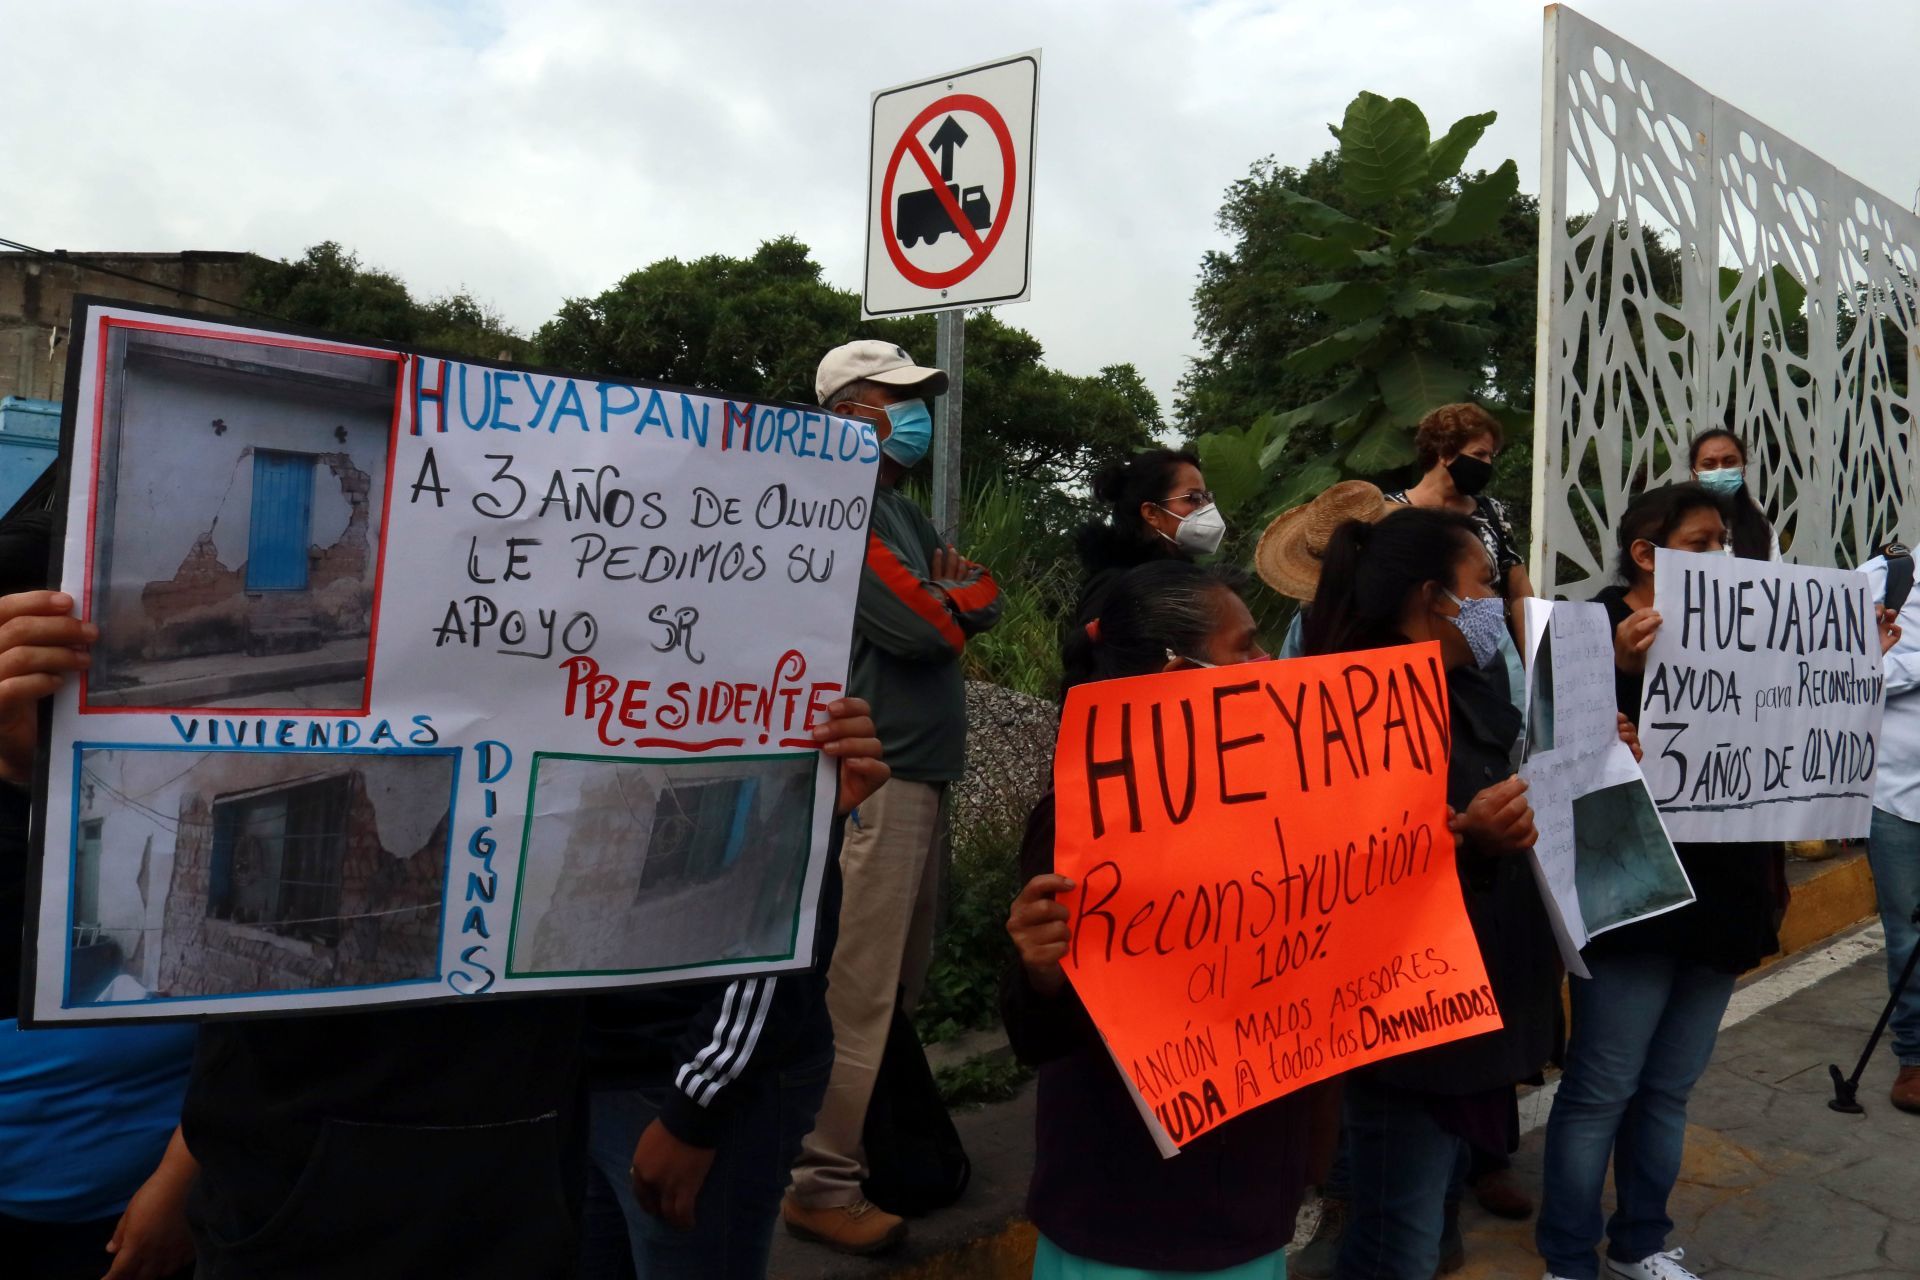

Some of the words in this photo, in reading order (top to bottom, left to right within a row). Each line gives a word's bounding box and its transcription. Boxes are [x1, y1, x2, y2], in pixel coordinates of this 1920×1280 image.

[409, 356, 709, 447] HUEYAPAN
[722, 399, 880, 463] MORELOS
[411, 447, 450, 507] A
[472, 454, 527, 518] 3
[539, 465, 667, 529] AÑOS
[691, 486, 743, 529] DE
[755, 484, 867, 530] OLVIDO
[467, 536, 543, 584] LE
[571, 533, 766, 584] PEDIMOS
[787, 544, 835, 583] SU
[432, 595, 599, 659] APOYO
[648, 605, 705, 665] SR
[171, 715, 439, 748] VIVIENDAS
[559, 649, 842, 747] PRESIDENTE
[1643, 662, 1741, 715] AYUDA
[1755, 684, 1792, 722] para
[1086, 656, 1450, 839] HUEYAPAN
[1650, 722, 1689, 805] 3
[1690, 742, 1753, 803] AÑOS
[1763, 745, 1795, 791] DE
[1802, 727, 1875, 786] OLVIDO
[447, 741, 512, 995] DIGNAS
[1072, 810, 1432, 968] Reconstrucción
[1188, 945, 1227, 1003] al
[1251, 921, 1332, 989] 100%
[1235, 998, 1311, 1056] MALOS
[1155, 1078, 1227, 1142] UDA
[1235, 1059, 1261, 1108] A
[1268, 1032, 1323, 1084] todos
[1330, 1023, 1357, 1059] los
